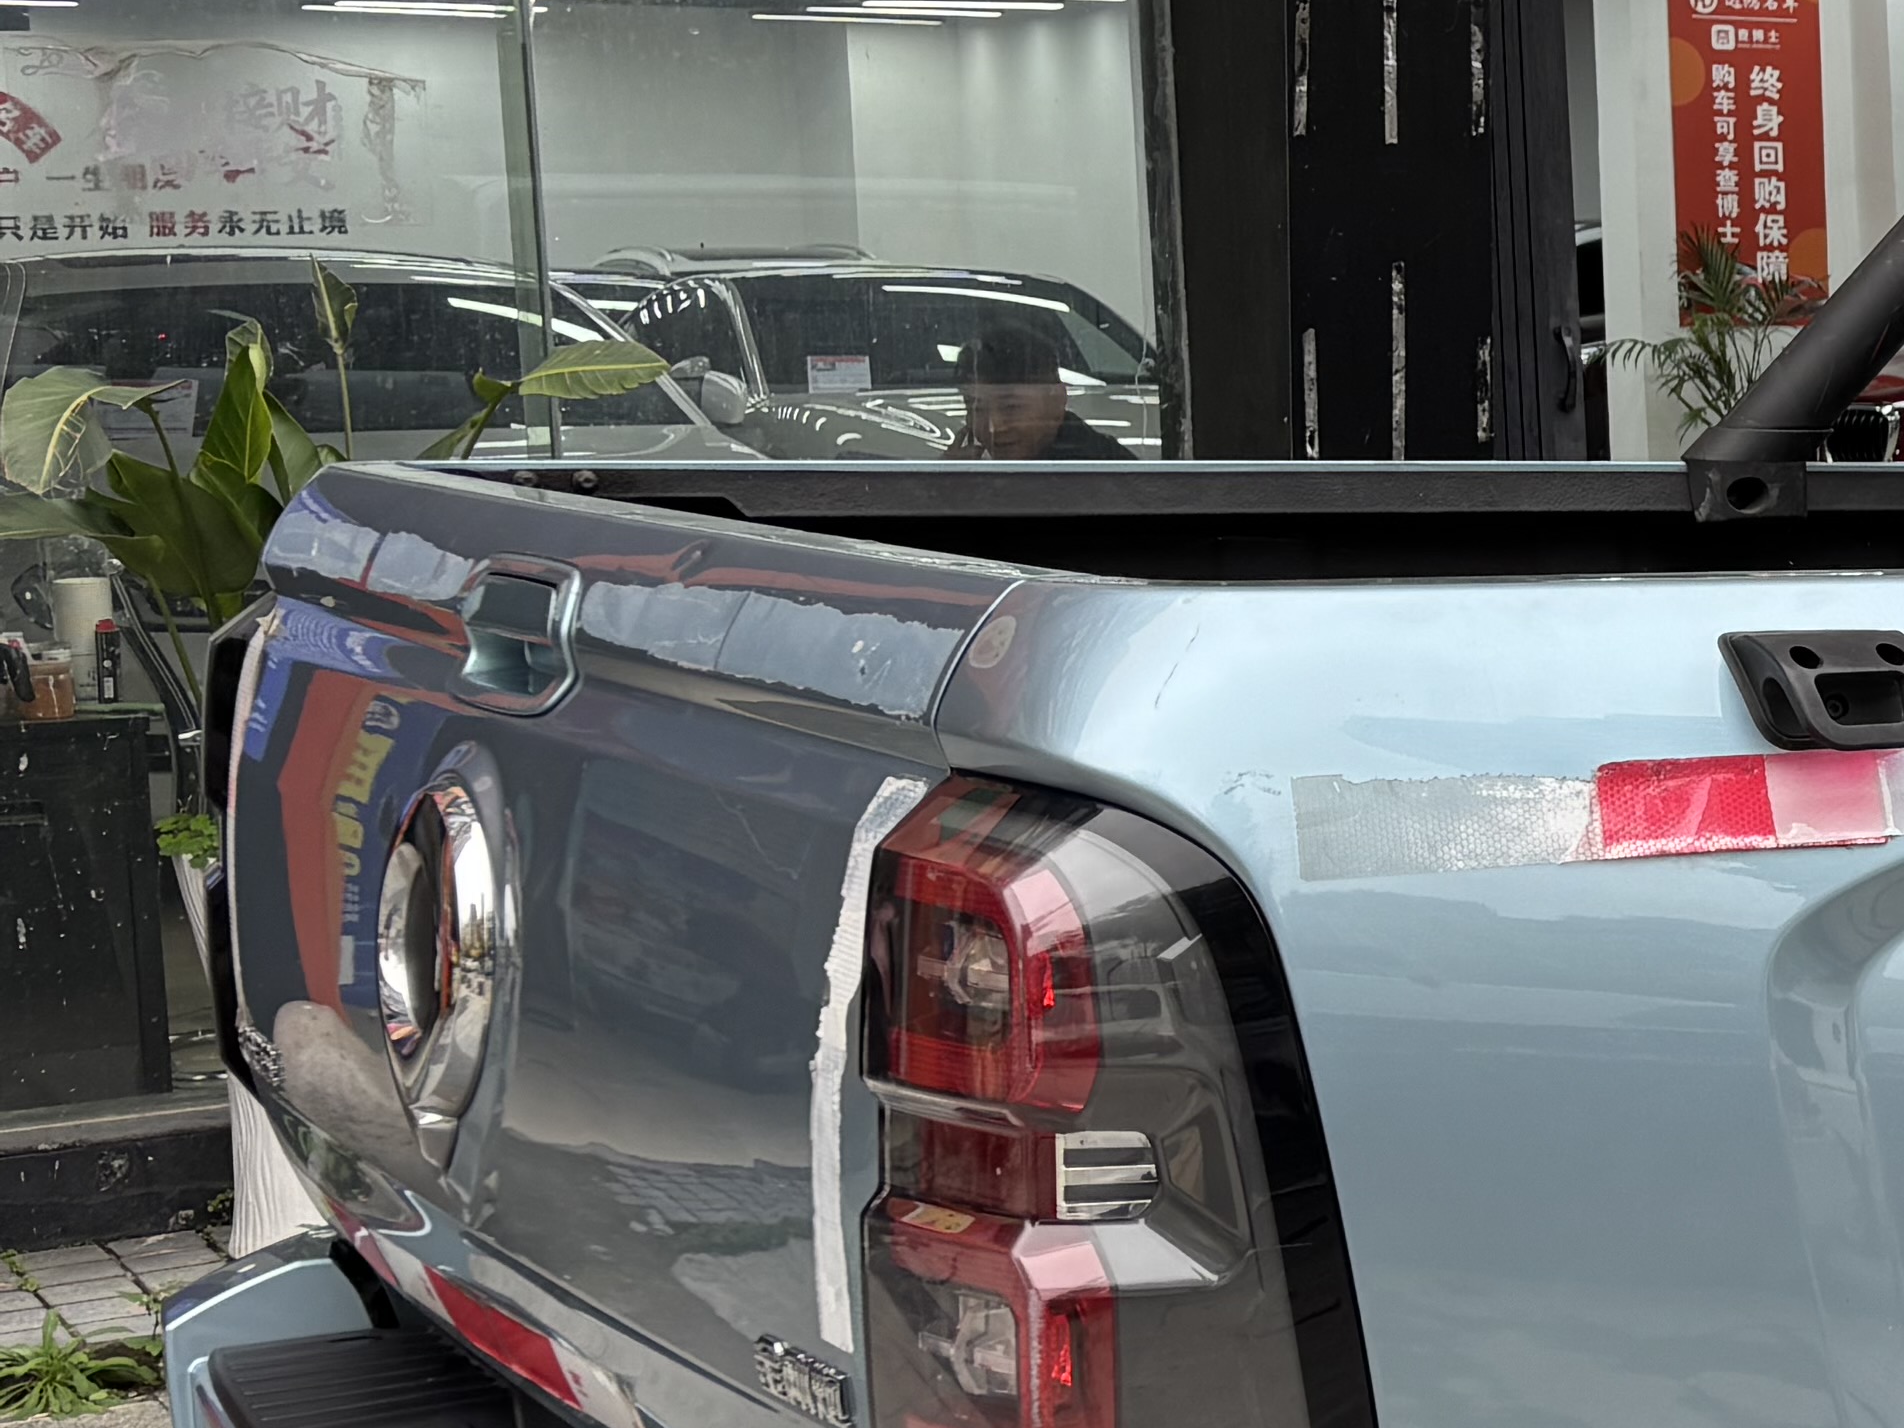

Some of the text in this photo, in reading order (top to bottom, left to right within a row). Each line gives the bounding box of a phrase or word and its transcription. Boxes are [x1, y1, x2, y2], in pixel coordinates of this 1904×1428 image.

[1711, 63, 1742, 244] 购车可享查博士
[1749, 64, 1789, 283] 终身回购保障
